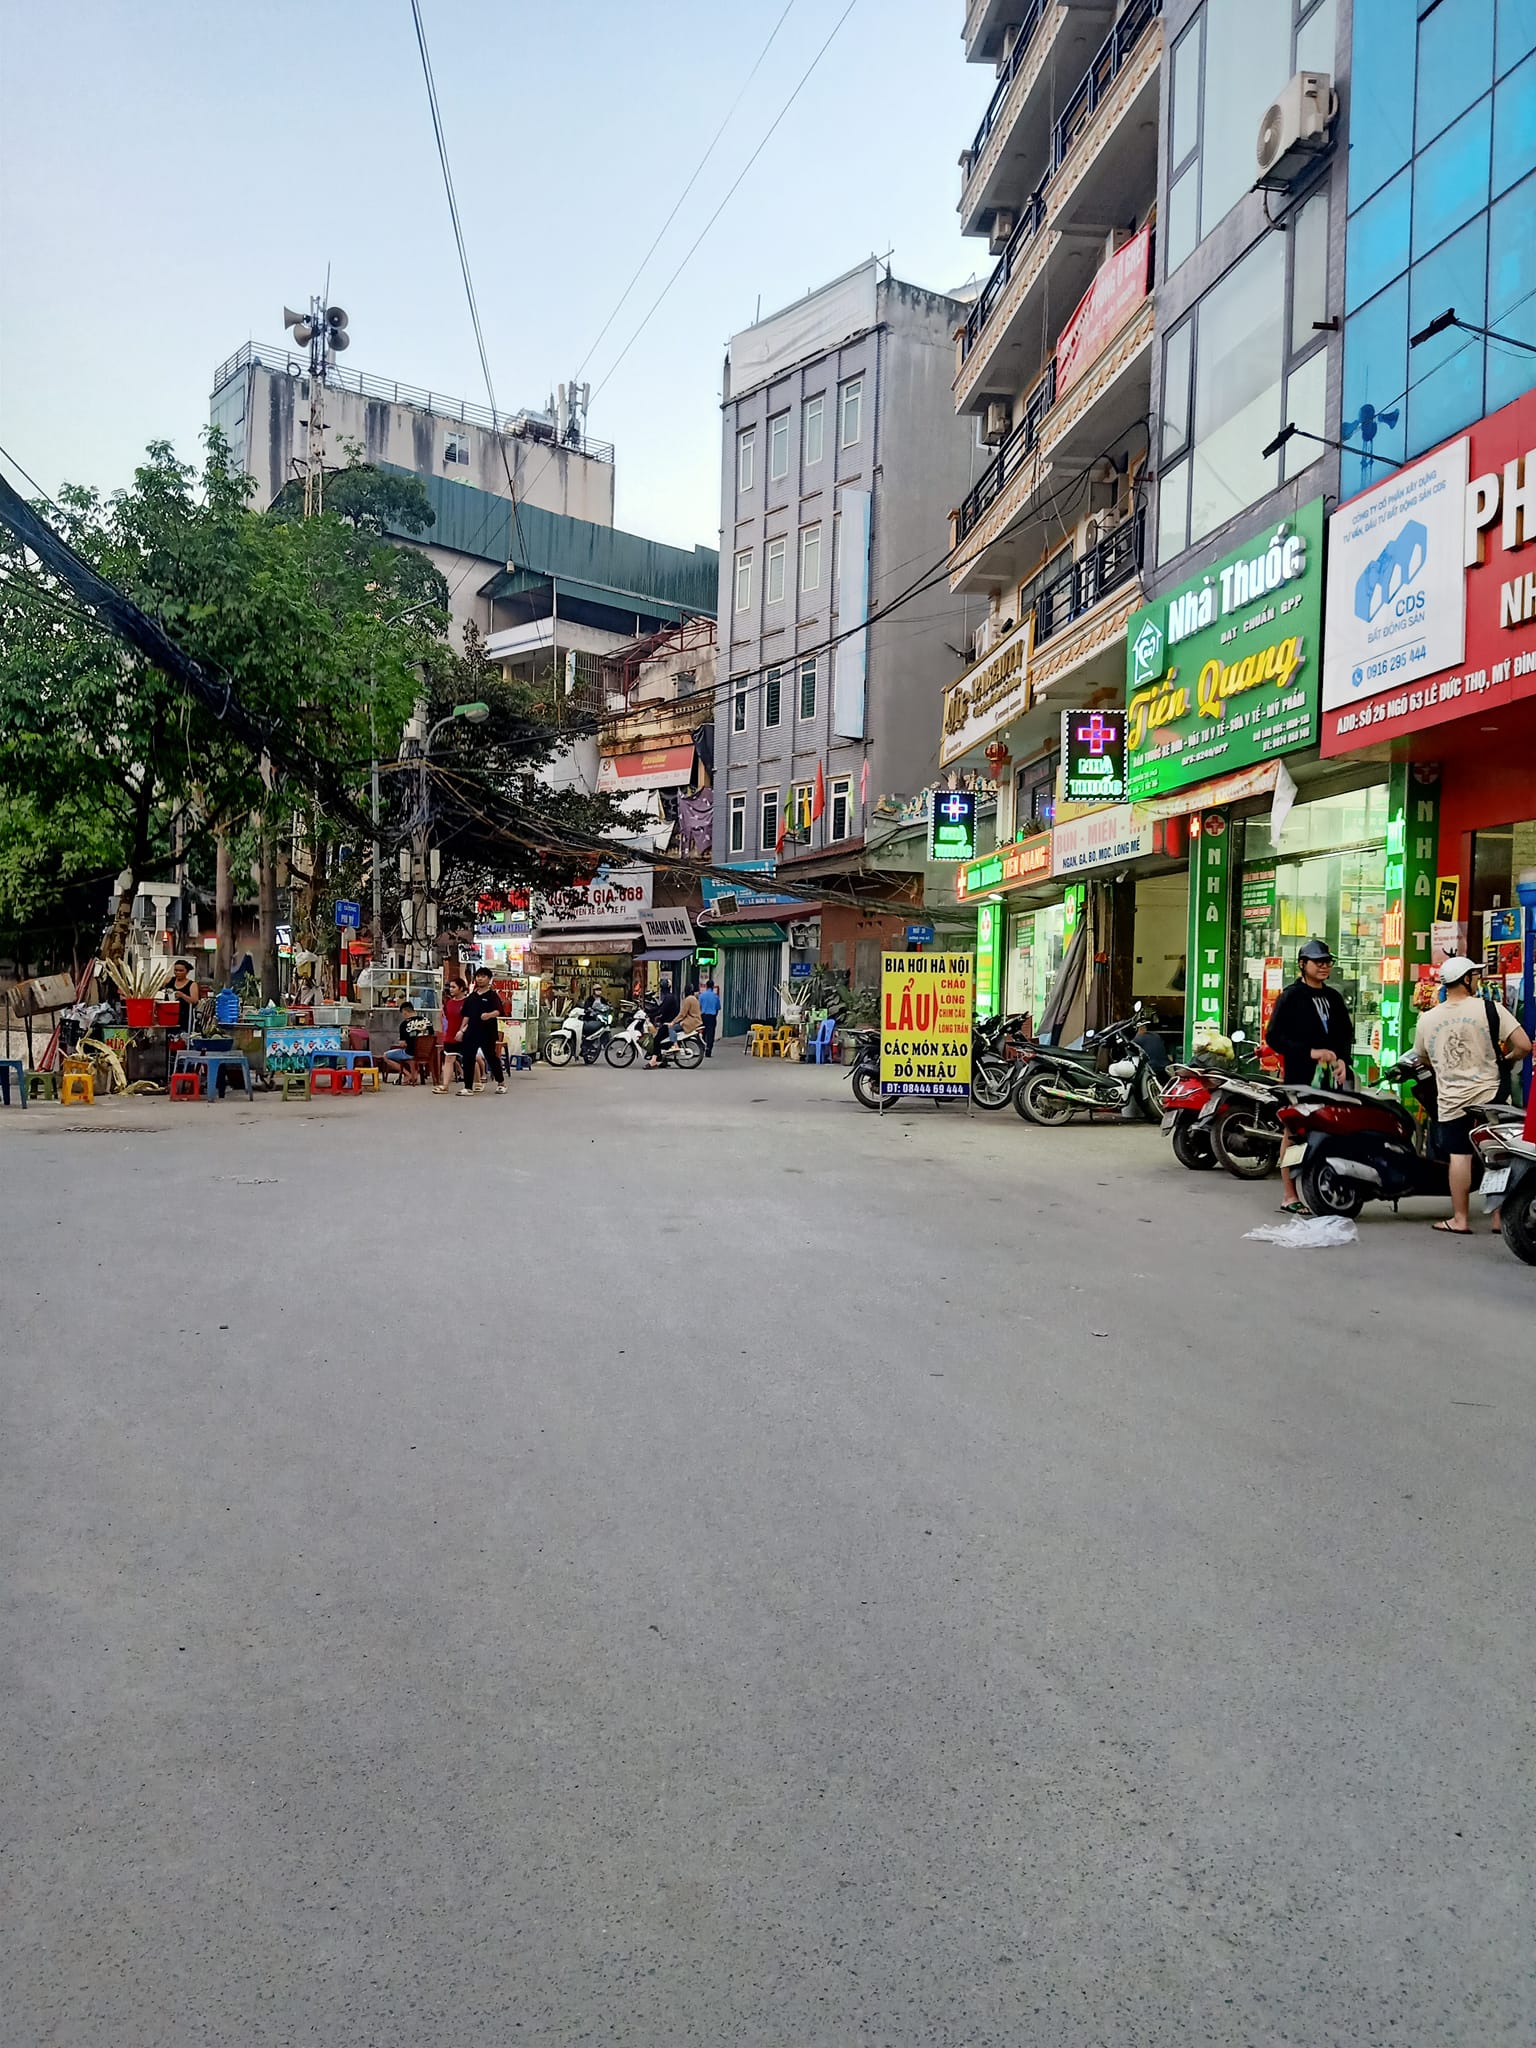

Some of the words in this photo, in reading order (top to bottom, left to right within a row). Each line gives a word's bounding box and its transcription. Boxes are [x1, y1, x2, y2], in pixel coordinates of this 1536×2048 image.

[1168, 575, 1216, 645] Nhà
[1219, 522, 1302, 615] Thuốc
[1281, 593, 1304, 615] GPP
[1395, 591, 1425, 617] CDS
[1366, 659, 1388, 680] 0916
[1390, 653, 1407, 671] 295
[1409, 644, 1427, 663] 444
[1127, 666, 1191, 750] Tiến
[1198, 636, 1304, 719] Quang
[1336, 713, 1358, 735] ADD:
[1373, 703, 1386, 723] 26
[1409, 690, 1423, 711] 63
[1424, 682, 1438, 706] LÊ
[1439, 675, 1462, 702] ĐỨC
[1464, 669, 1490, 694] THỌ,
[1206, 847, 1222, 923] NHÀ
[885, 958, 905, 973] BIA
[908, 957, 927, 973] HƠI
[931, 956, 946, 973] HÀ
[949, 957, 969, 976] NỘI
[885, 977, 930, 1032] LẨU
[884, 1039, 909, 1056] CÁC
[912, 1039, 939, 1056] MÓN
[942, 1040, 968, 1057] XÀO
[917, 1061, 957, 1081] NHẬU
[886, 1082, 901, 1094] ĐT:
[902, 1083, 931, 1095] 08444
[932, 1084, 945, 1095] 69
[946, 1085, 964, 1095] 444
